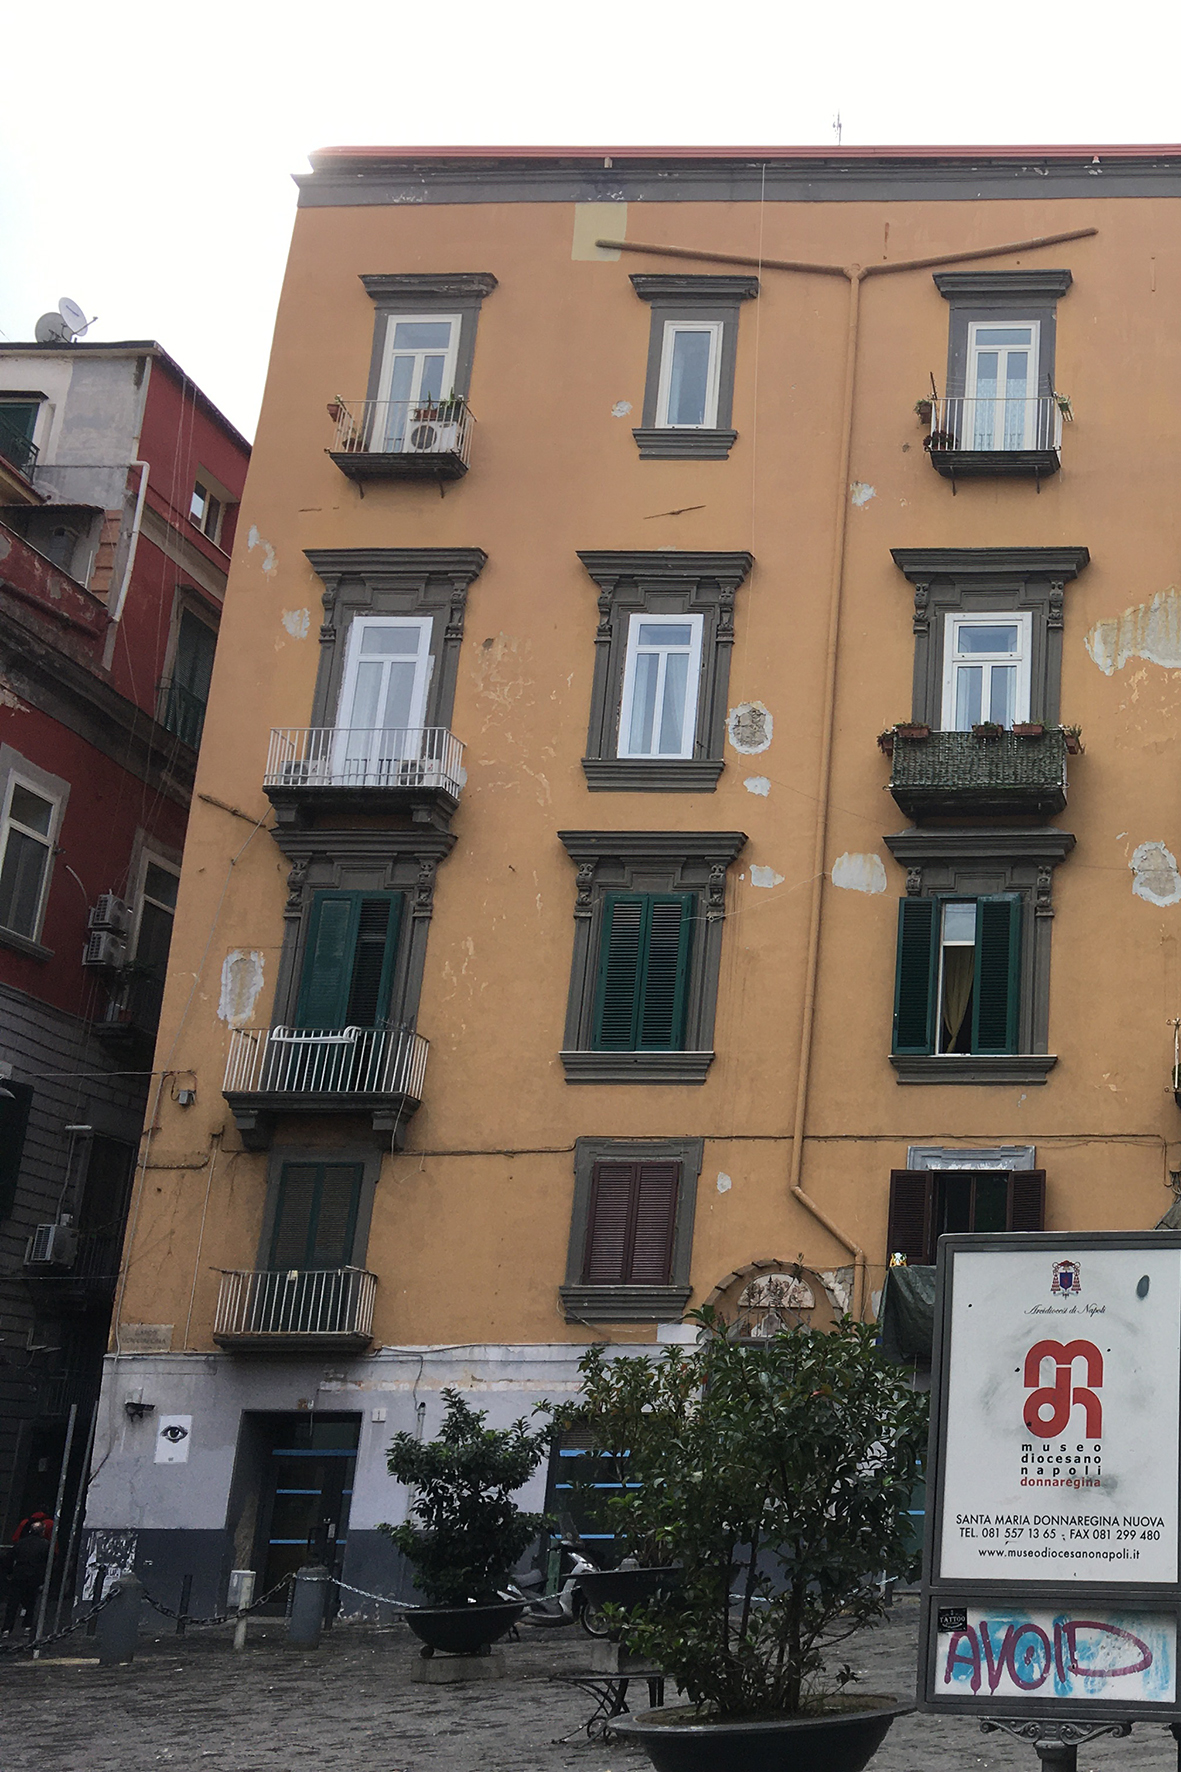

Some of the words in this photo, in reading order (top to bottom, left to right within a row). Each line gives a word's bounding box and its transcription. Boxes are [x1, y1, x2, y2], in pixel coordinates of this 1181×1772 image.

[1069, 1305, 1078, 1314] di
[1077, 1302, 1106, 1318] Napoli
[1021, 1443, 1101, 1452] museo
[1021, 1453, 1101, 1464] diocesano
[1020, 1465, 1101, 1477] napoli
[1020, 1476, 1101, 1490] donnaregina
[956, 1514, 992, 1525] SANTA
[994, 1514, 1030, 1526] MARIA
[1033, 1515, 1120, 1527] DONNAREGINA
[1123, 1516, 1165, 1528] NUOVA
[959, 1527, 979, 1538] TEL.
[981, 1527, 1000, 1539] 081
[1004, 1527, 1024, 1539] 557
[1029, 1528, 1039, 1539] 13
[1042, 1528, 1056, 1539] 65
[1069, 1529, 1090, 1540] FAX
[1092, 1529, 1111, 1540] 081
[1116, 1529, 1136, 1541] 299
[1139, 1530, 1161, 1541] 480
[978, 1547, 1140, 1562] www.museodiocesanonapoli.it
[944, 1620, 1153, 1695] AVOID
